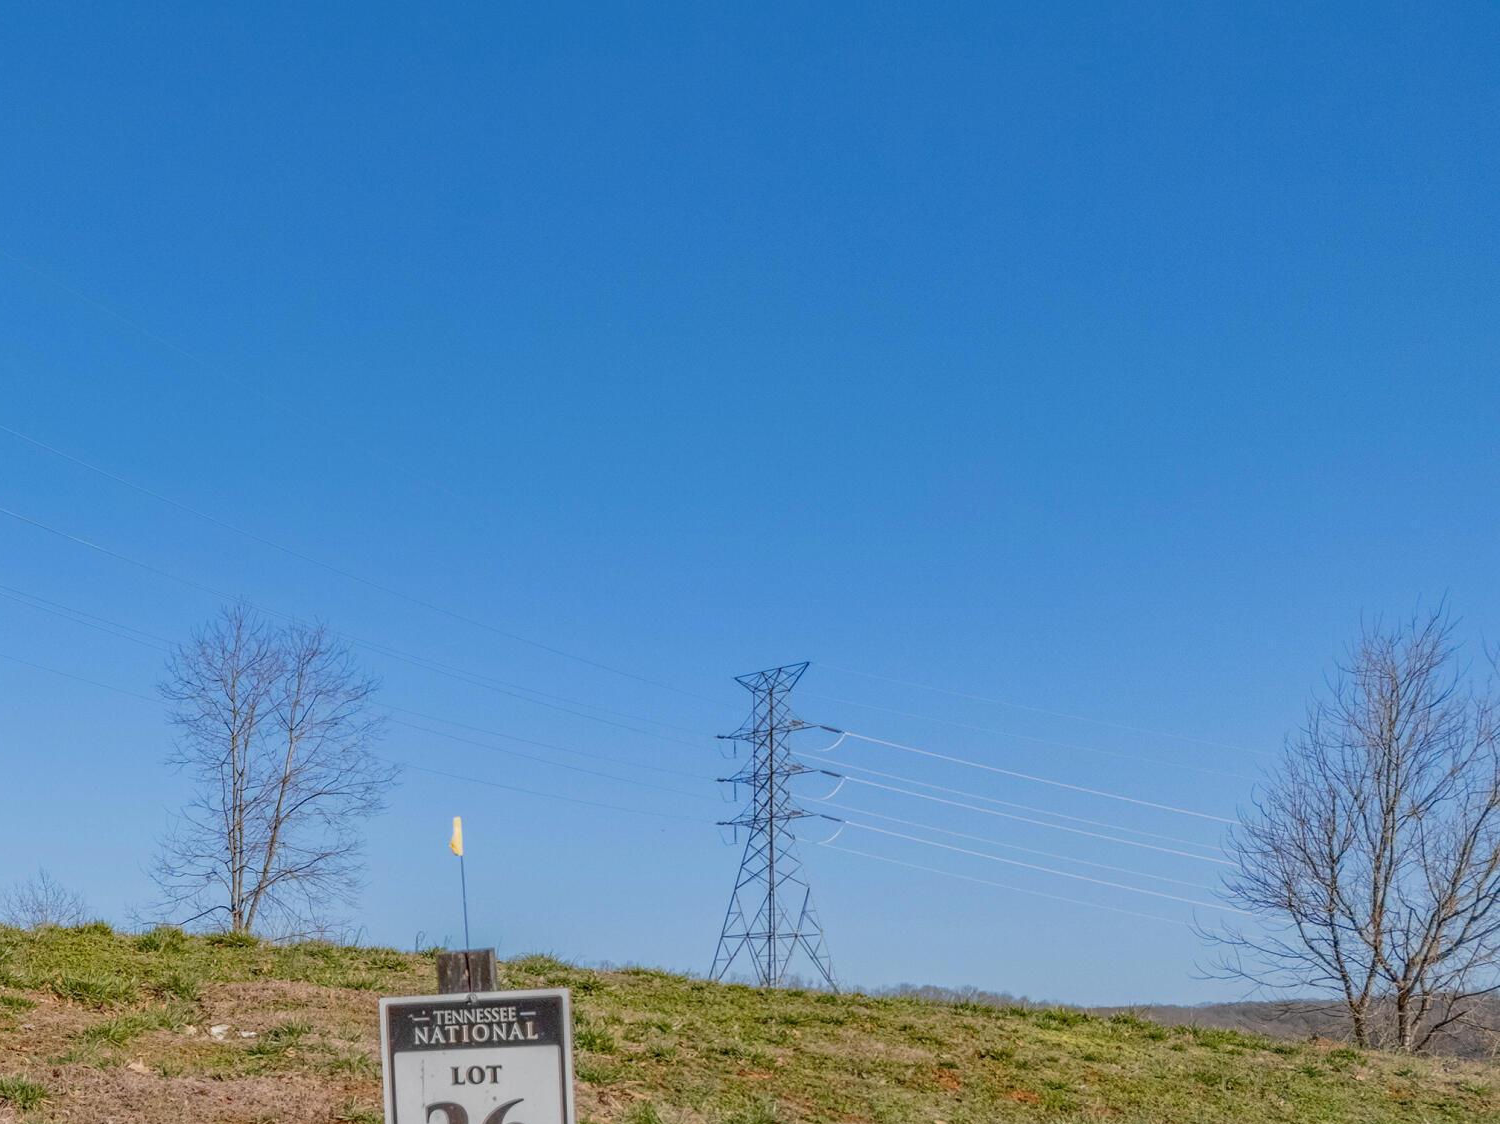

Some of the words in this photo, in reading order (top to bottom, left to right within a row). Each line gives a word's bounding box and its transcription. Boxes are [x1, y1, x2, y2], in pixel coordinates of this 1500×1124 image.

[433, 1006, 517, 1025] TENNESSEE
[414, 1021, 539, 1045] NATIONAL
[450, 1065, 503, 1086] LOT
